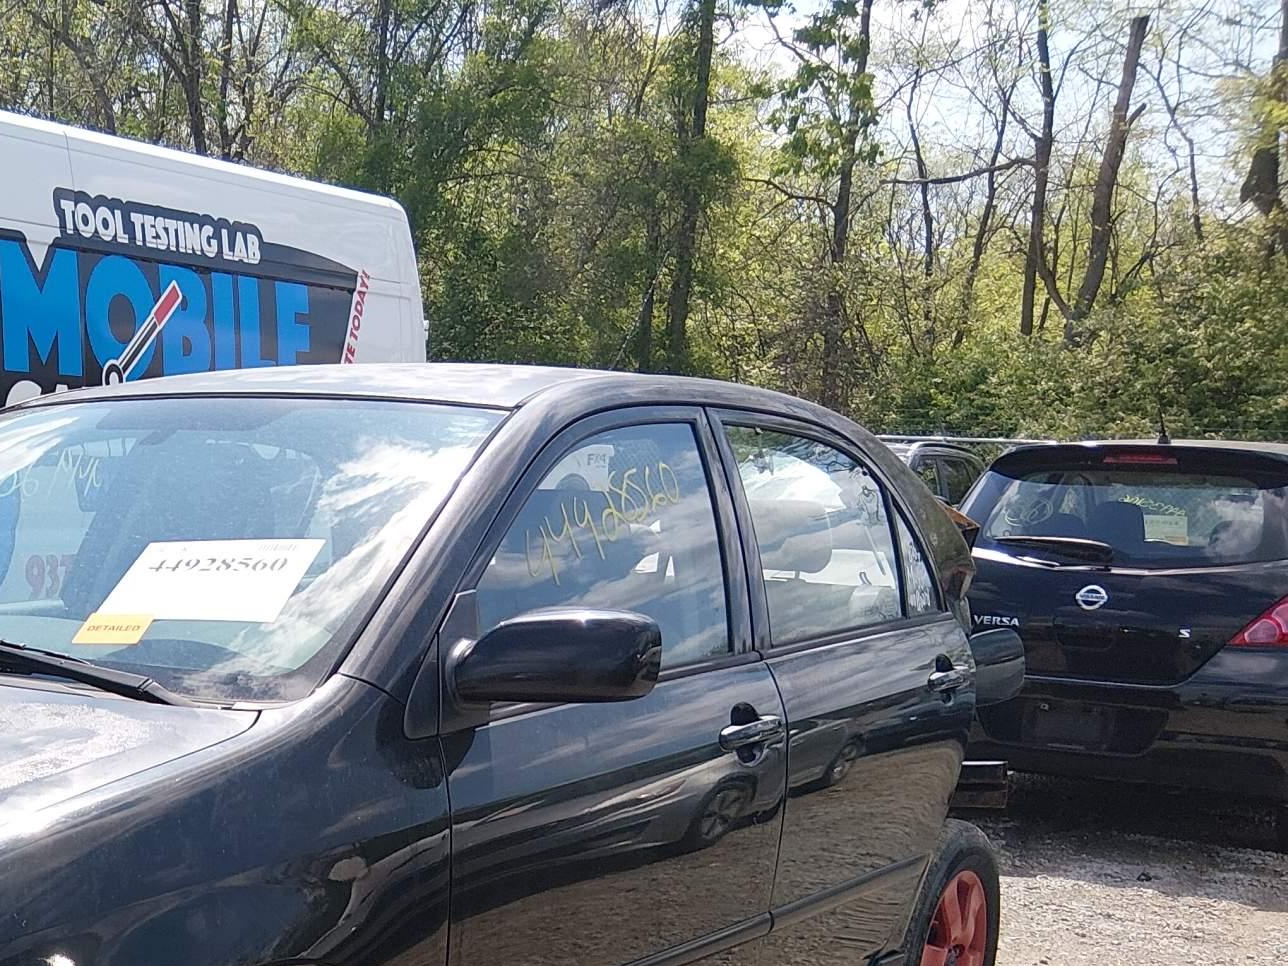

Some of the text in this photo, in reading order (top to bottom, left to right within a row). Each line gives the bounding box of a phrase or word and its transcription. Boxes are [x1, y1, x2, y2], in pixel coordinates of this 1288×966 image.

[60, 199, 262, 265] TOOL TESTING LAB
[349, 269, 370, 341] TODAY!
[524, 461, 680, 586] 44928560
[148, 556, 289, 573] 44928560
[86, 624, 141, 632] DETAILED
[973, 614, 1020, 627] VERSA
[1178, 628, 1191, 639] S
